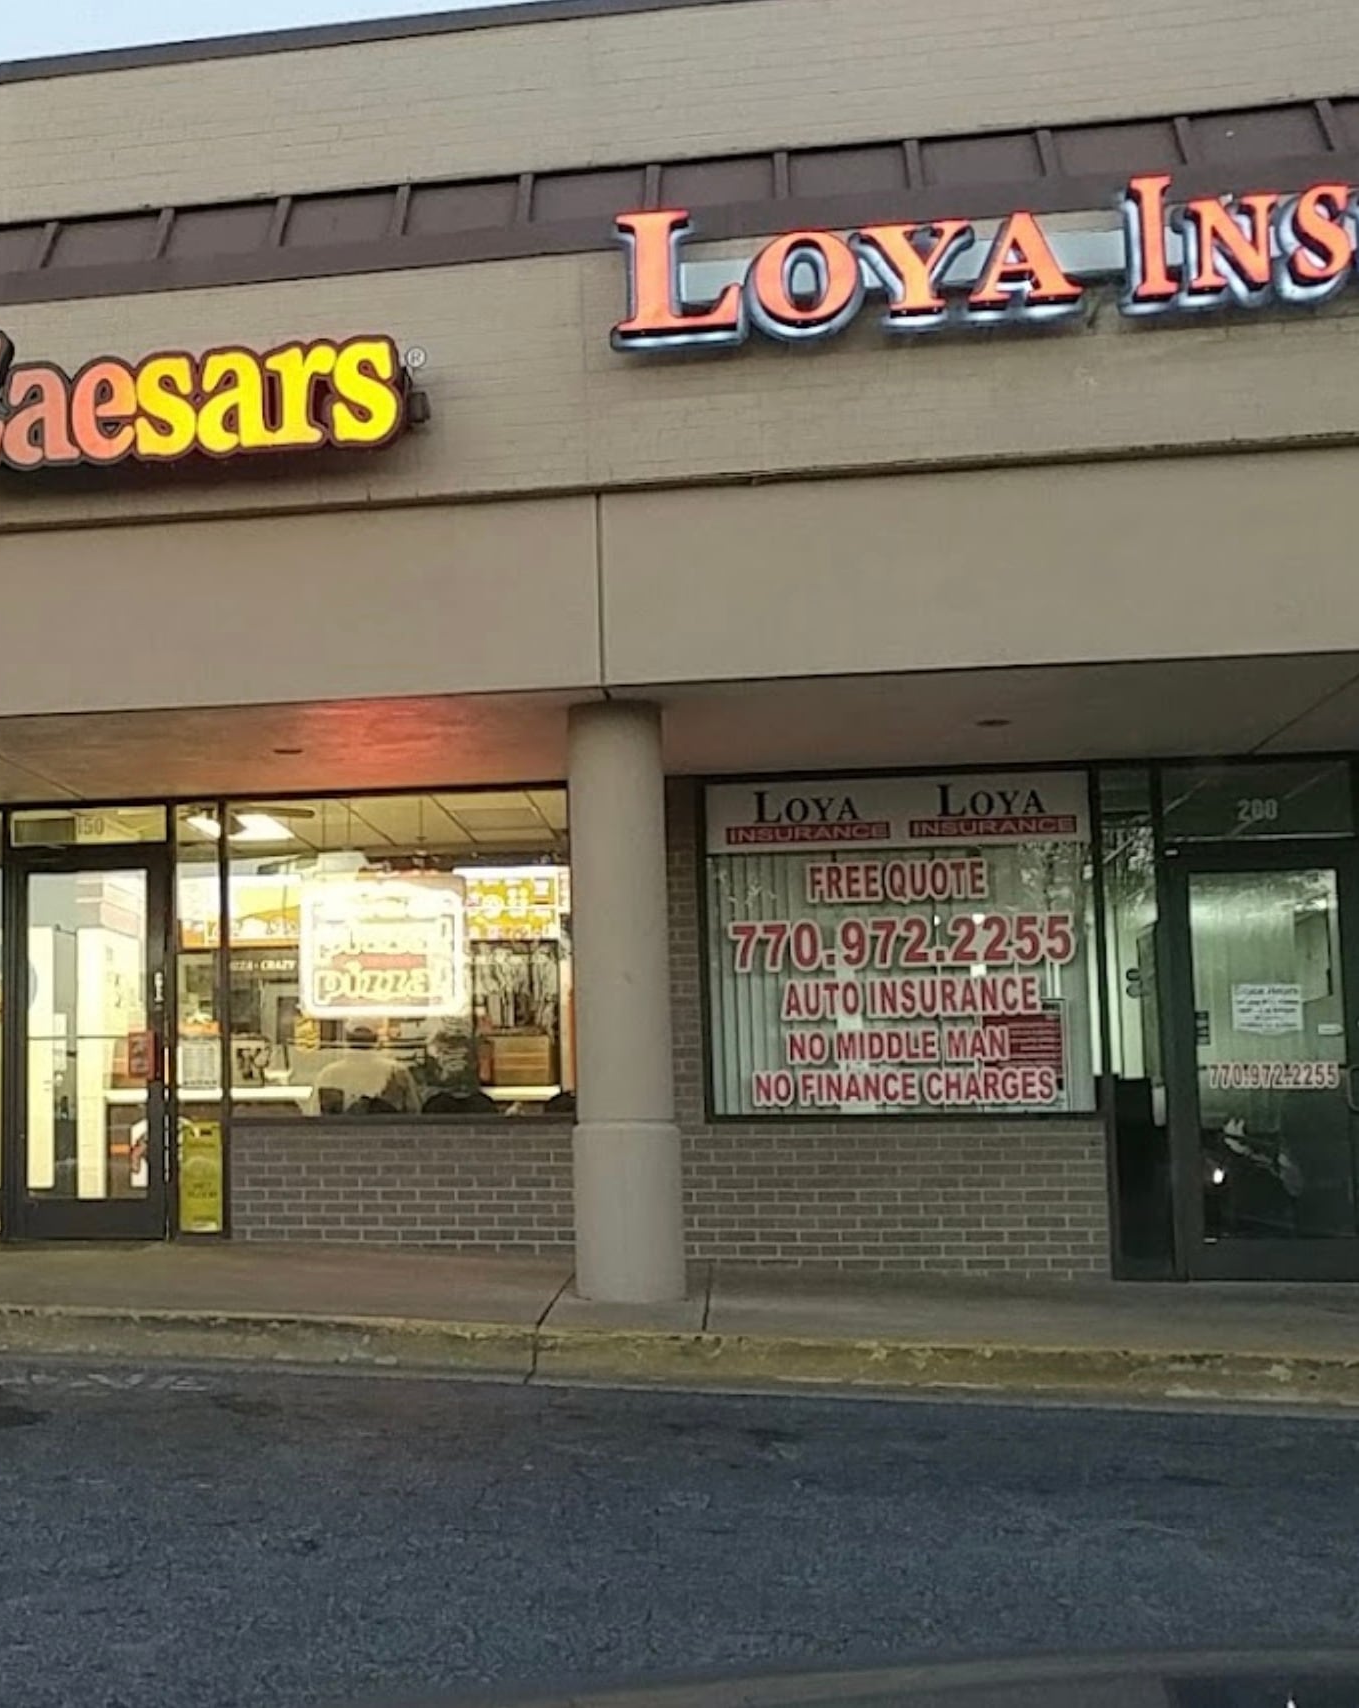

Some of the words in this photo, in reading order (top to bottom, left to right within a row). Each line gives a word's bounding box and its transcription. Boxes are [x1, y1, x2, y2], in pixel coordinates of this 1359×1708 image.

[612, 208, 1085, 345] LOYA
[1123, 172, 1359, 310] INS
[753, 790, 860, 824] LOYA
[937, 783, 1047, 817] LOYA
[1237, 798, 1278, 821] 200
[727, 823, 890, 844] INSURANCE
[911, 816, 1076, 837] INSURANCE
[808, 863, 881, 901] FREE
[887, 859, 987, 903] QUOTE
[729, 913, 1075, 972] 770.972.2255
[782, 979, 861, 1021] AUTO
[866, 975, 1040, 1017] INSURANCE
[787, 1031, 827, 1064] NO
[834, 1028, 939, 1063] MIDDLE
[947, 1025, 1010, 1060] MAN
[753, 1071, 793, 1106] NO
[799, 1069, 917, 1105] FINANCE
[924, 1067, 1059, 1103] CHARGES
